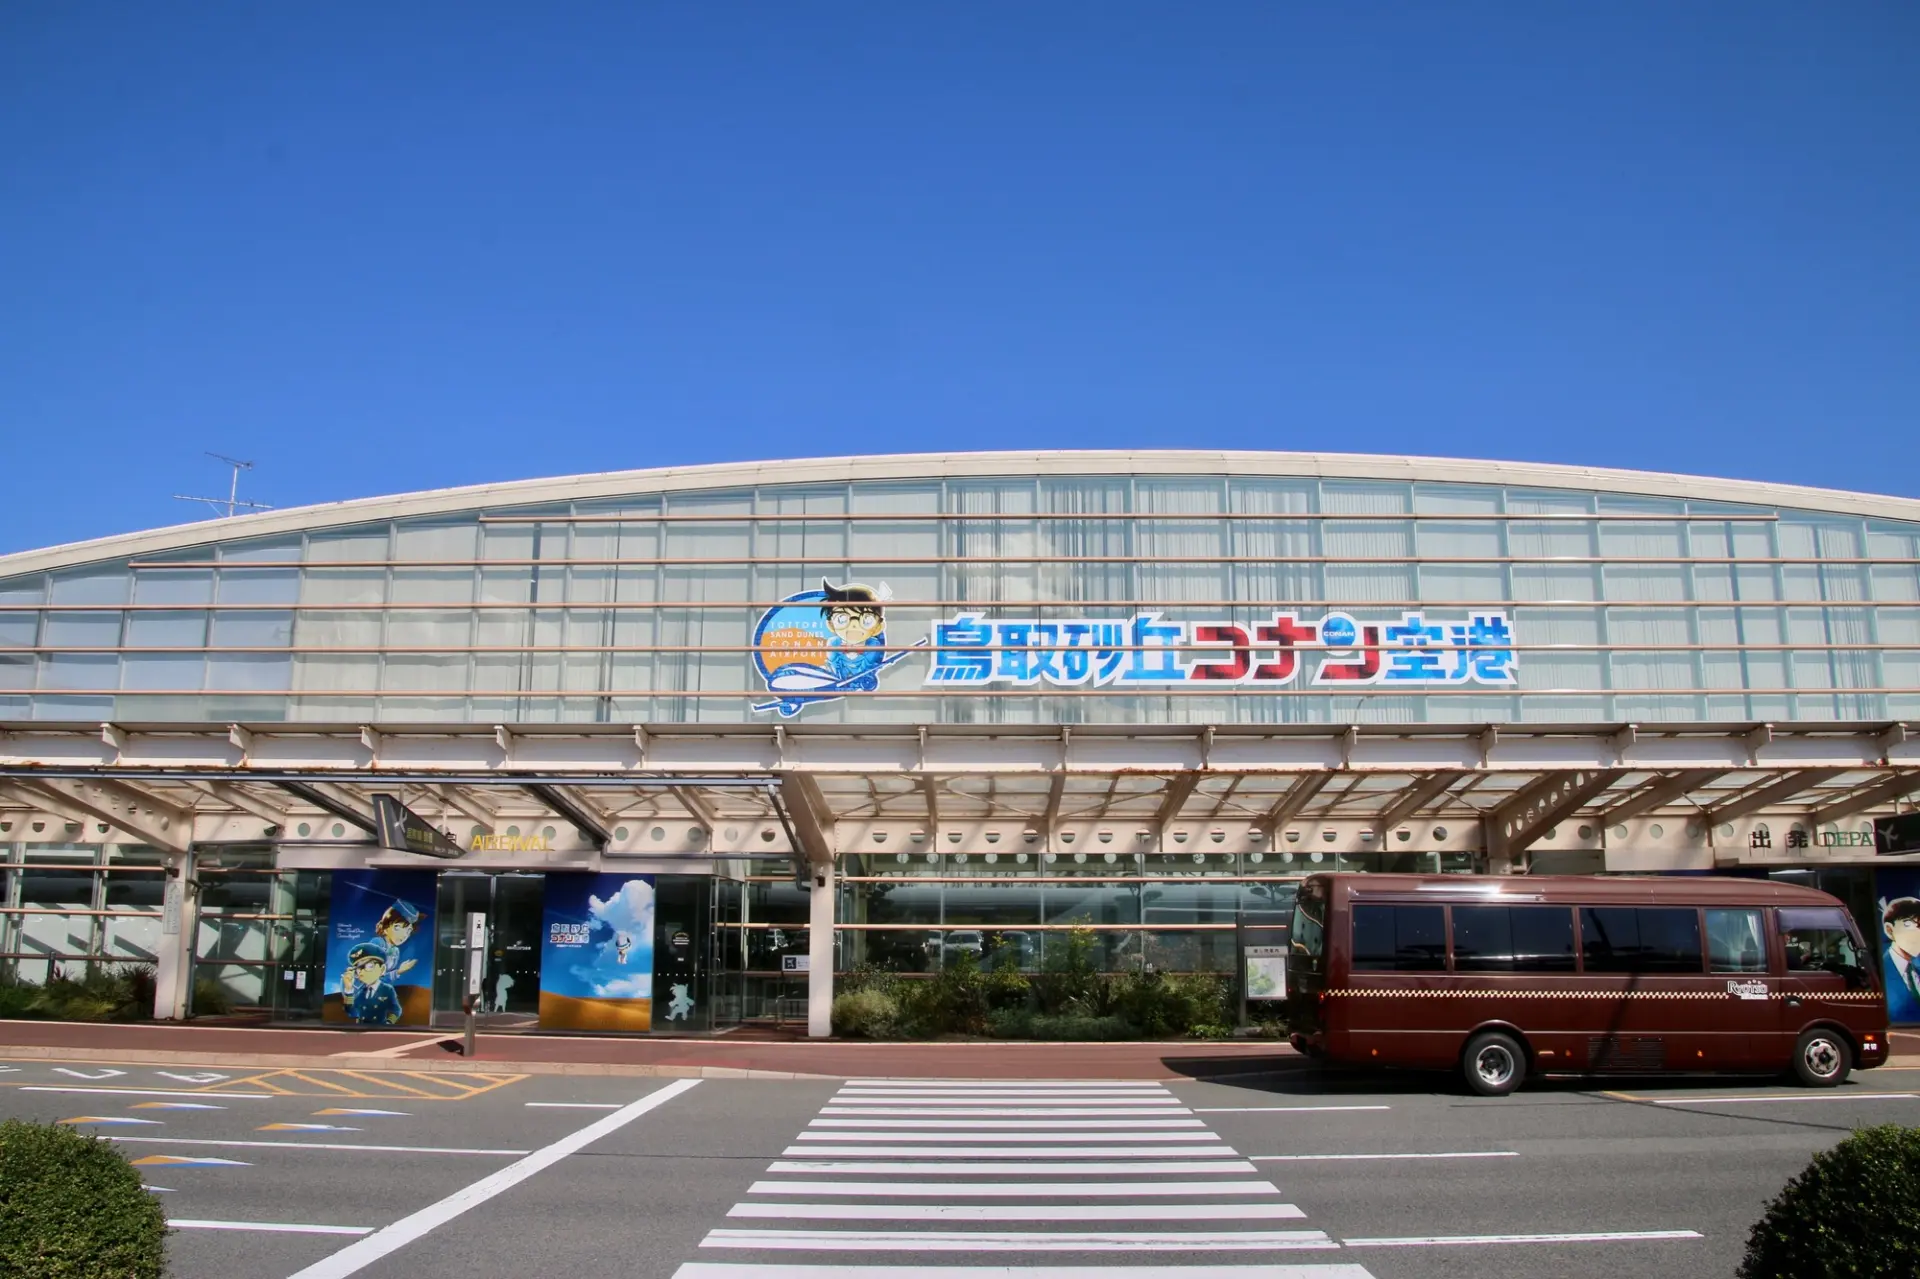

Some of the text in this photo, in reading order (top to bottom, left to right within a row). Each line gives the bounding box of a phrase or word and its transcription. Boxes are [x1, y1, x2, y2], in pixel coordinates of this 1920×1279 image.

[770, 621, 824, 629] TOTTORI
[770, 631, 825, 639] SAND DUNES
[770, 640, 825, 648] CONAN
[929, 614, 1513, 683] 鳥取砂丘コナン空港
[769, 651, 824, 659] AIRPORT
[471, 834, 553, 852] ARRIVAL
[1752, 830, 1809, 849] 出発
